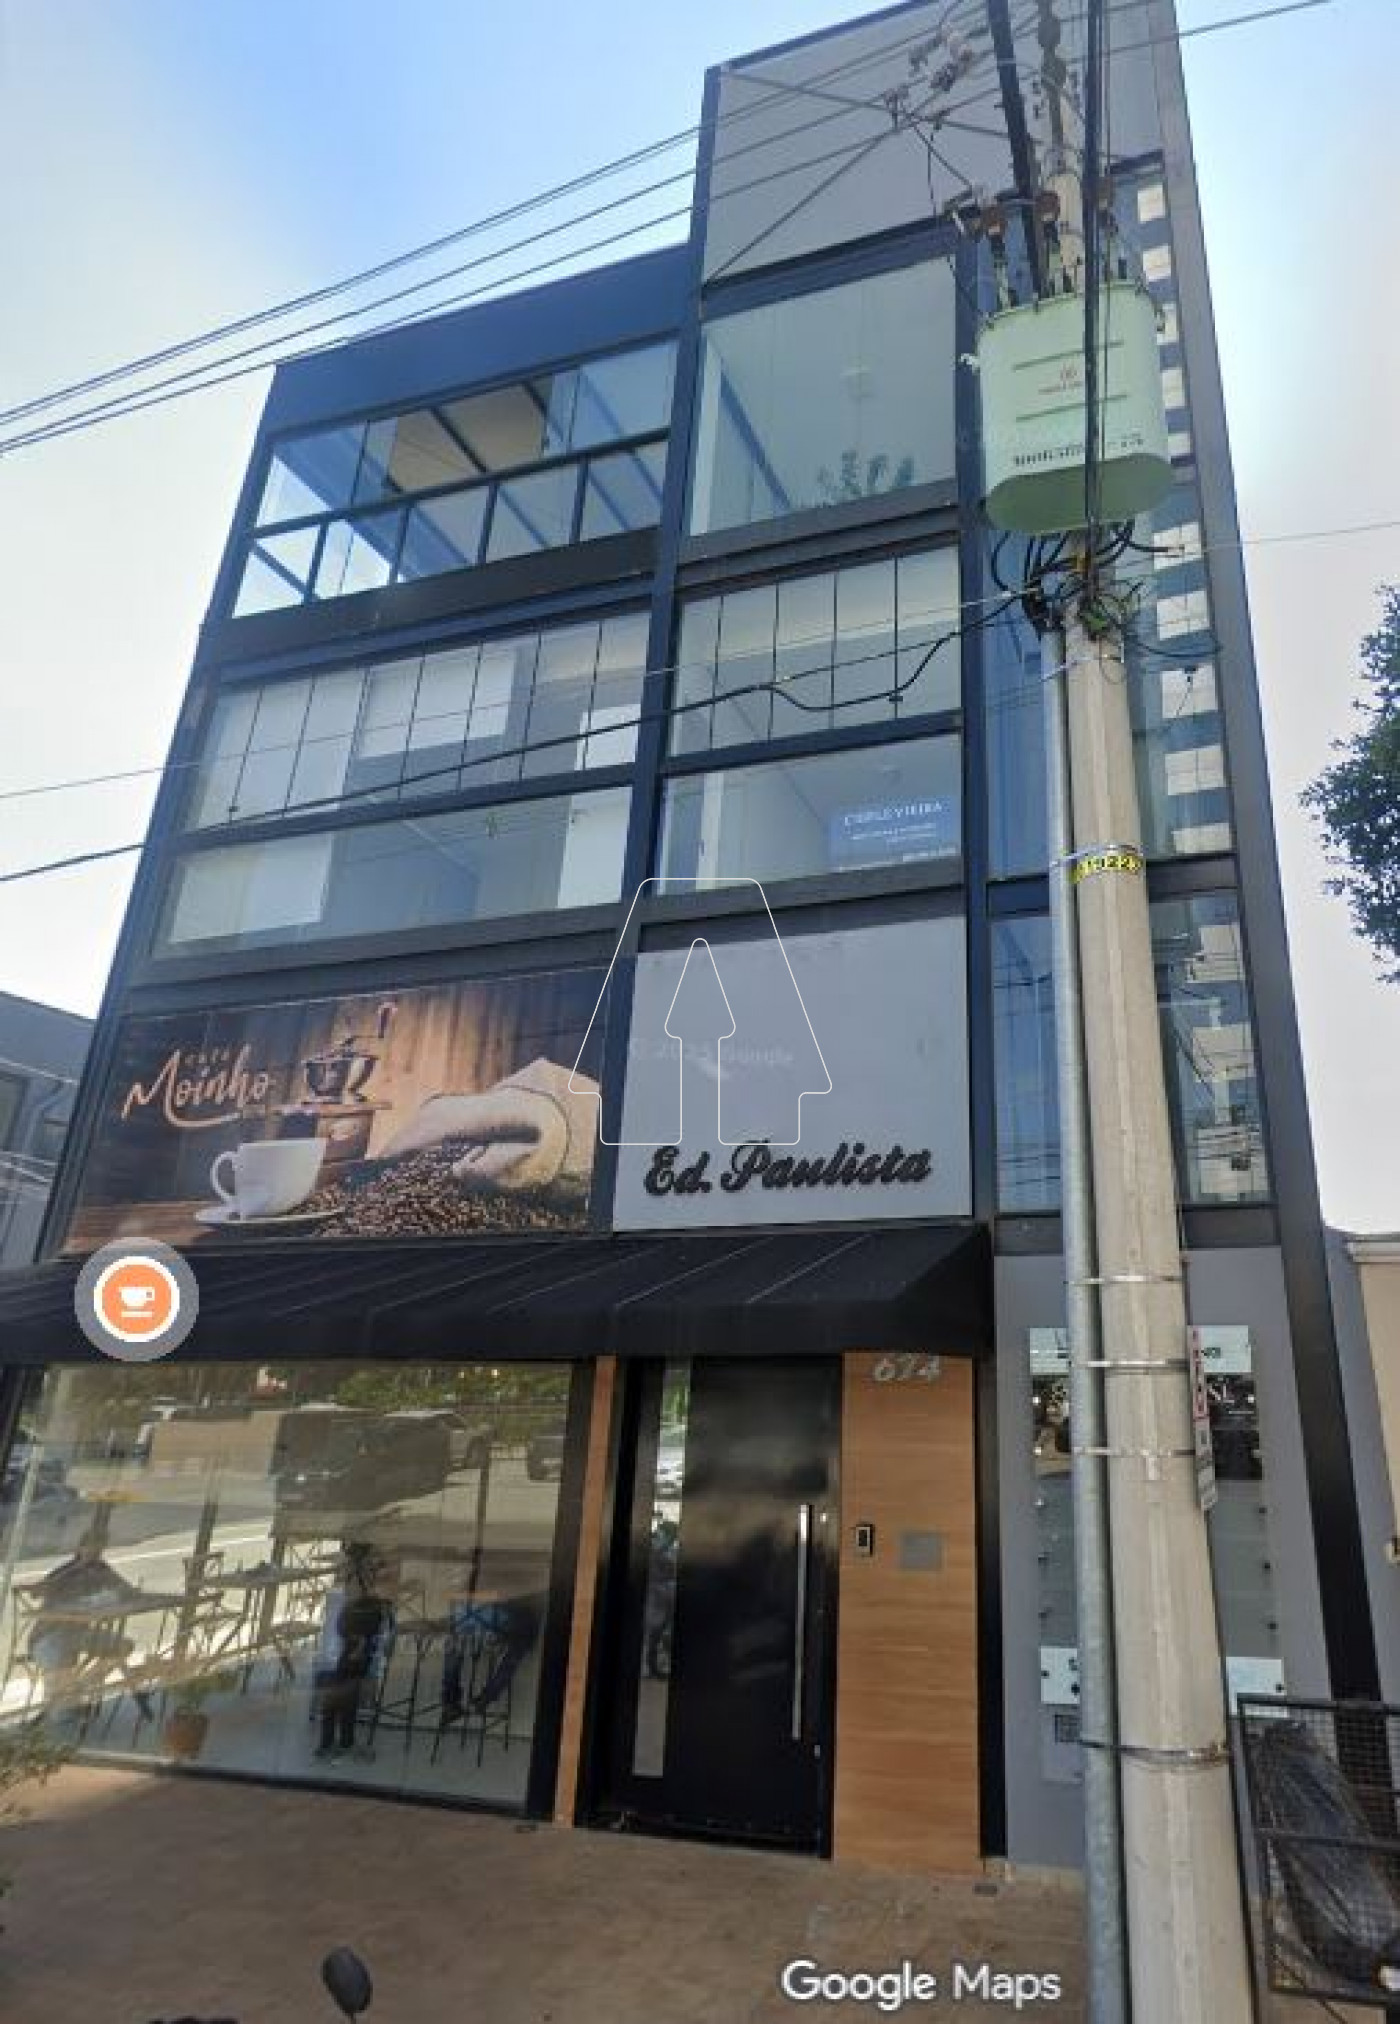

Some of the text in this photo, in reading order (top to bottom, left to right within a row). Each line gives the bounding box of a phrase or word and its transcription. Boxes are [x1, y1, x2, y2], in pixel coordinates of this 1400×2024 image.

[121, 1043, 272, 1128] Moinho
[643, 1138, 932, 1196] Ed. Paulista
